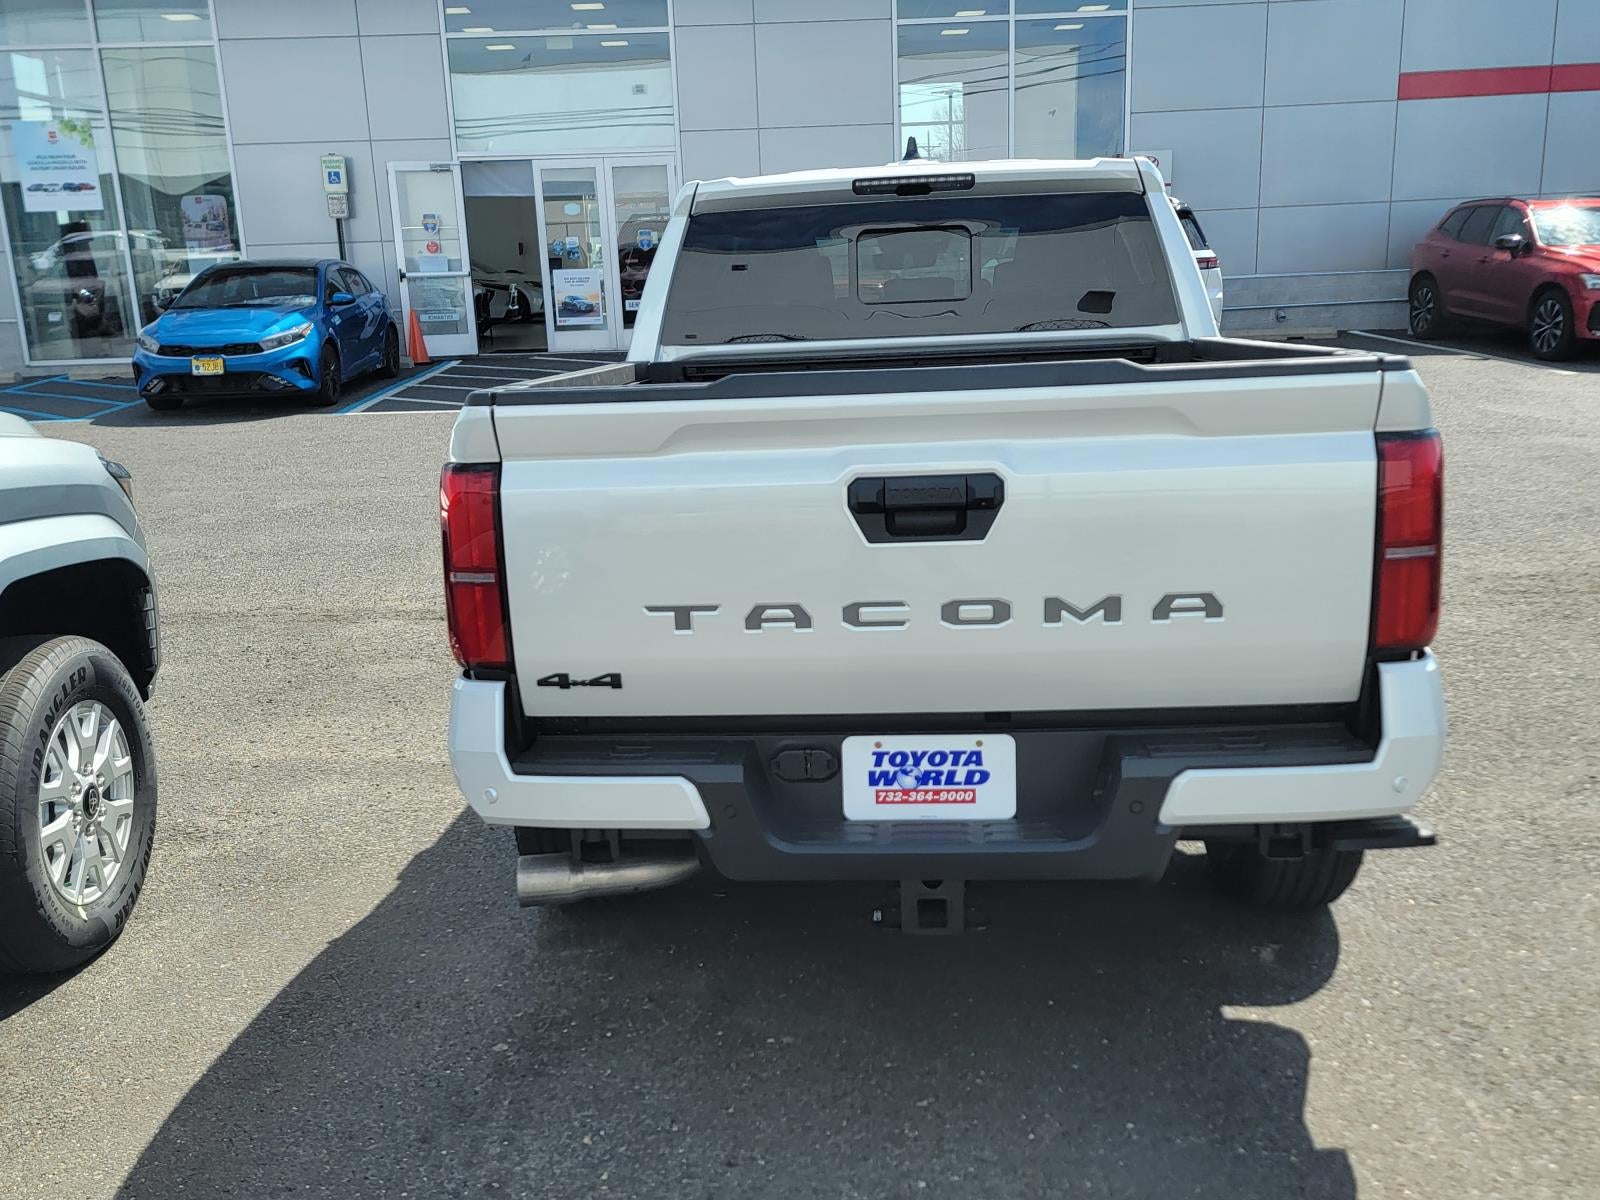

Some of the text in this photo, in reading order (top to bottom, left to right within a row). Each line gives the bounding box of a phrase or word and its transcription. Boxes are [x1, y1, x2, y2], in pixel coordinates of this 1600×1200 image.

[887, 486, 963, 500] TOYOTA
[642, 592, 1225, 634] TACOMA
[30, 666, 87, 794] WRANGLER
[871, 749, 983, 768] TOYOTA
[868, 767, 991, 788] WORLD
[878, 790, 974, 802] 732-364-9000
